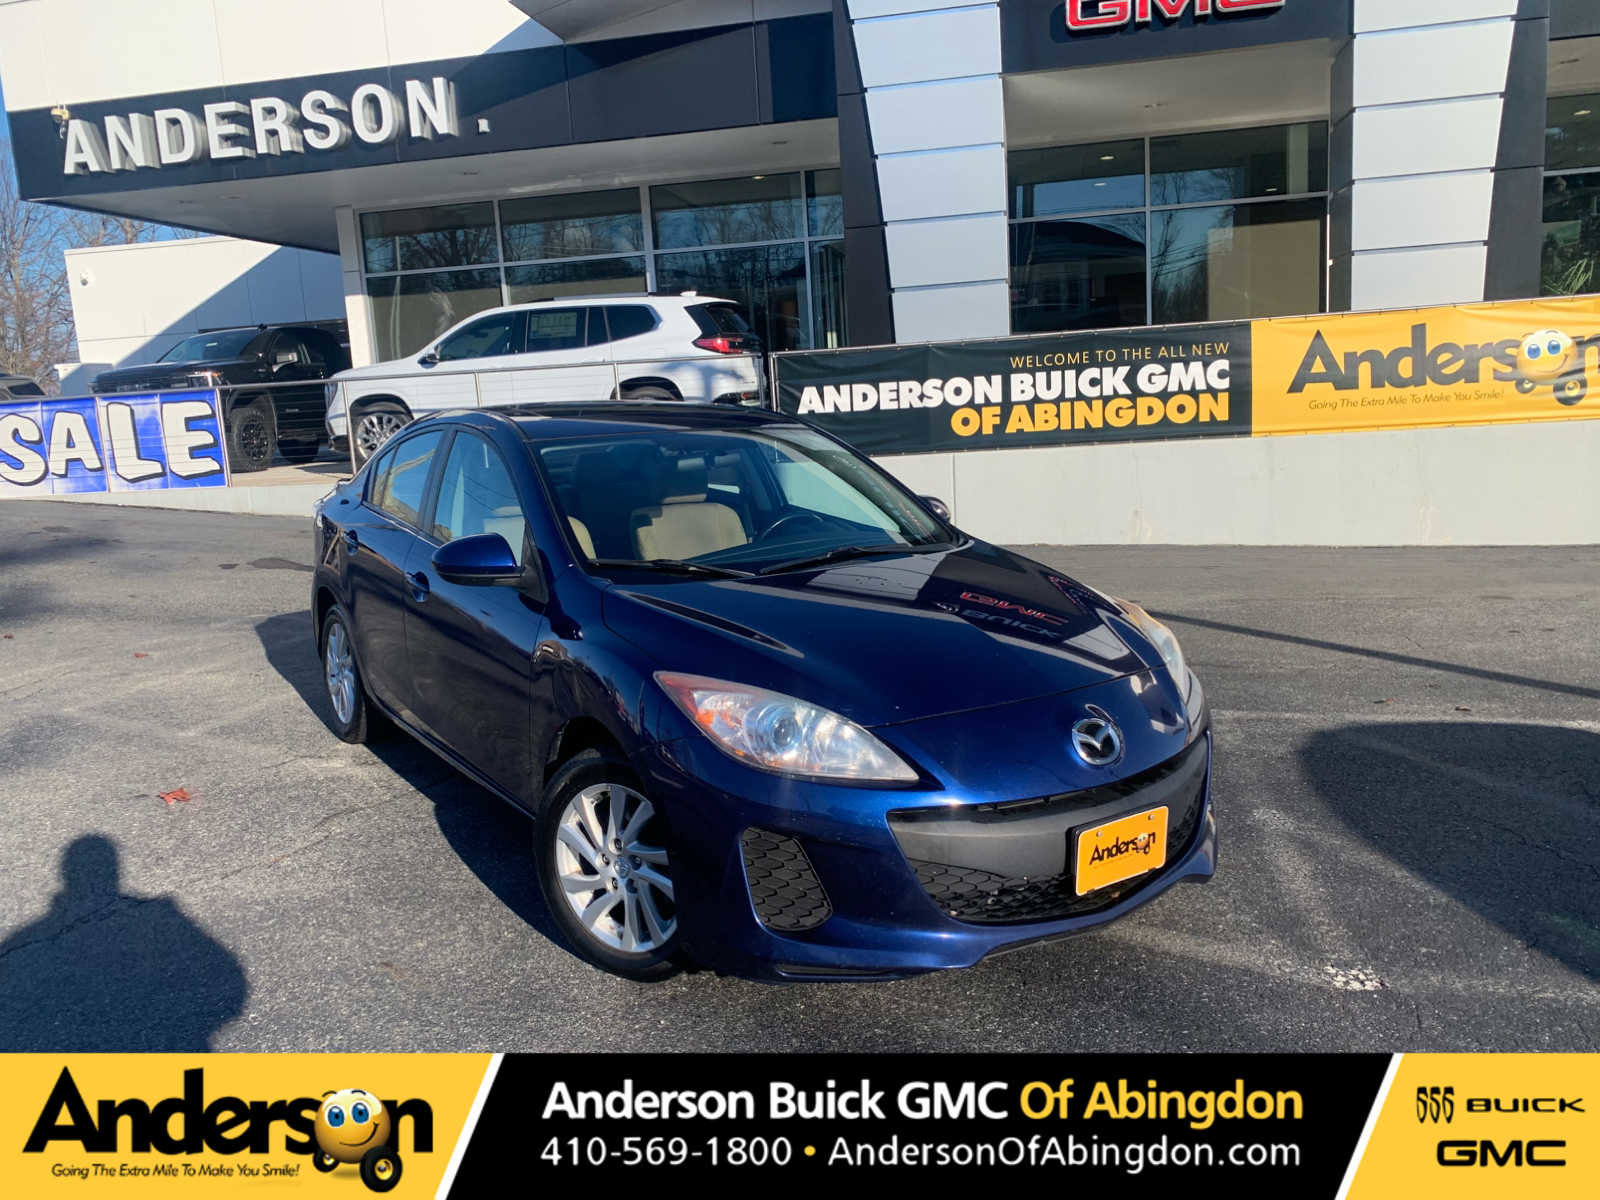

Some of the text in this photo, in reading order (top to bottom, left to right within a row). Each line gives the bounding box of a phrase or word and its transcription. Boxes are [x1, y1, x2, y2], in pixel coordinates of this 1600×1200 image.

[1065, 0, 1286, 30] GM
[1009, 342, 1229, 369] WELCOME TO THE ALL NEW
[797, 359, 1230, 415] ANDERSON BUICK GMC
[1308, 388, 1505, 411] Going The Extra Mile To Make You Smile!
[950, 392, 1230, 437] OF ABINGDON
[0, 400, 222, 486] SALE
